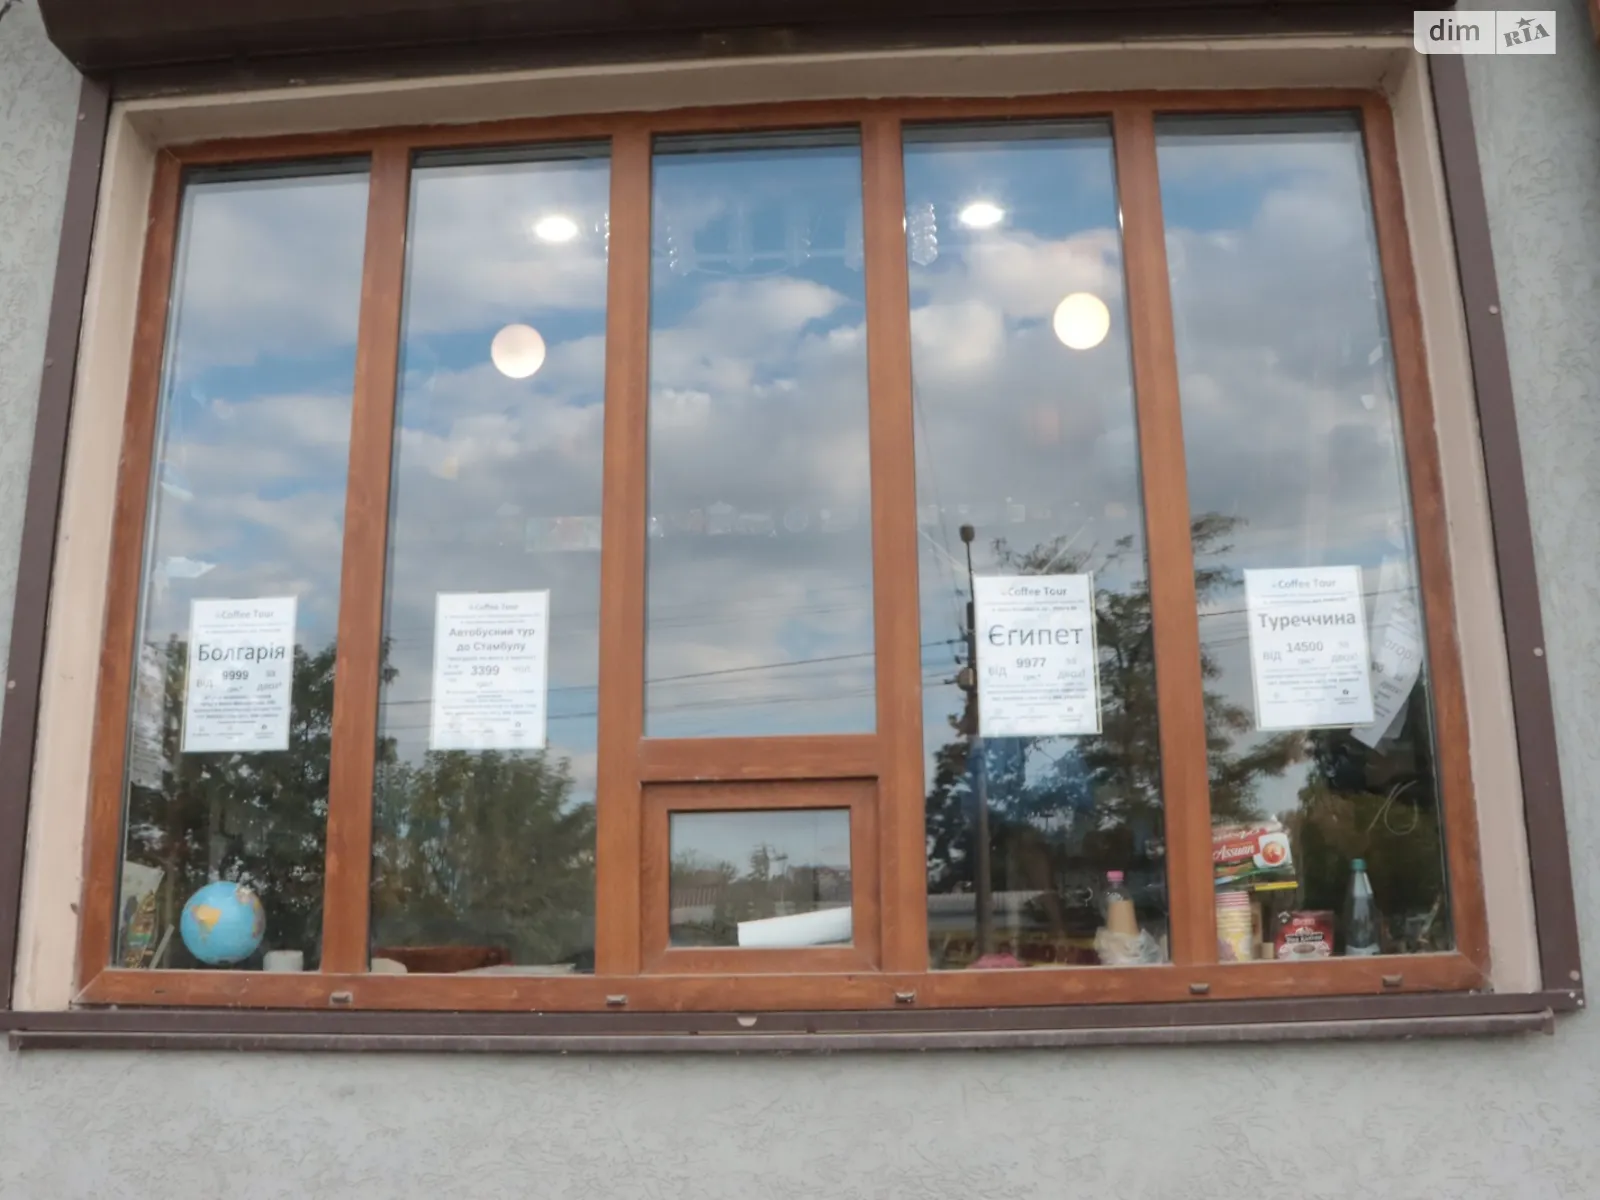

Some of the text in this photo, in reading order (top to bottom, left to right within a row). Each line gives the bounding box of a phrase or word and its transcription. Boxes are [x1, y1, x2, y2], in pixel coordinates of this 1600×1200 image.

[1278, 578, 1336, 589] Coffee Tour
[1008, 587, 1067, 596] Coffee Tour
[1258, 612, 1356, 631] Туреччина
[448, 628, 535, 638] Автобусний тур
[988, 624, 1083, 647] Єгипет
[456, 642, 526, 652] до Стамбулу
[1286, 641, 1323, 653] 14500
[198, 642, 285, 664] Болгарія
[1016, 657, 1047, 668] 9977
[222, 670, 249, 680] 9999
[470, 665, 500, 676] 3399
